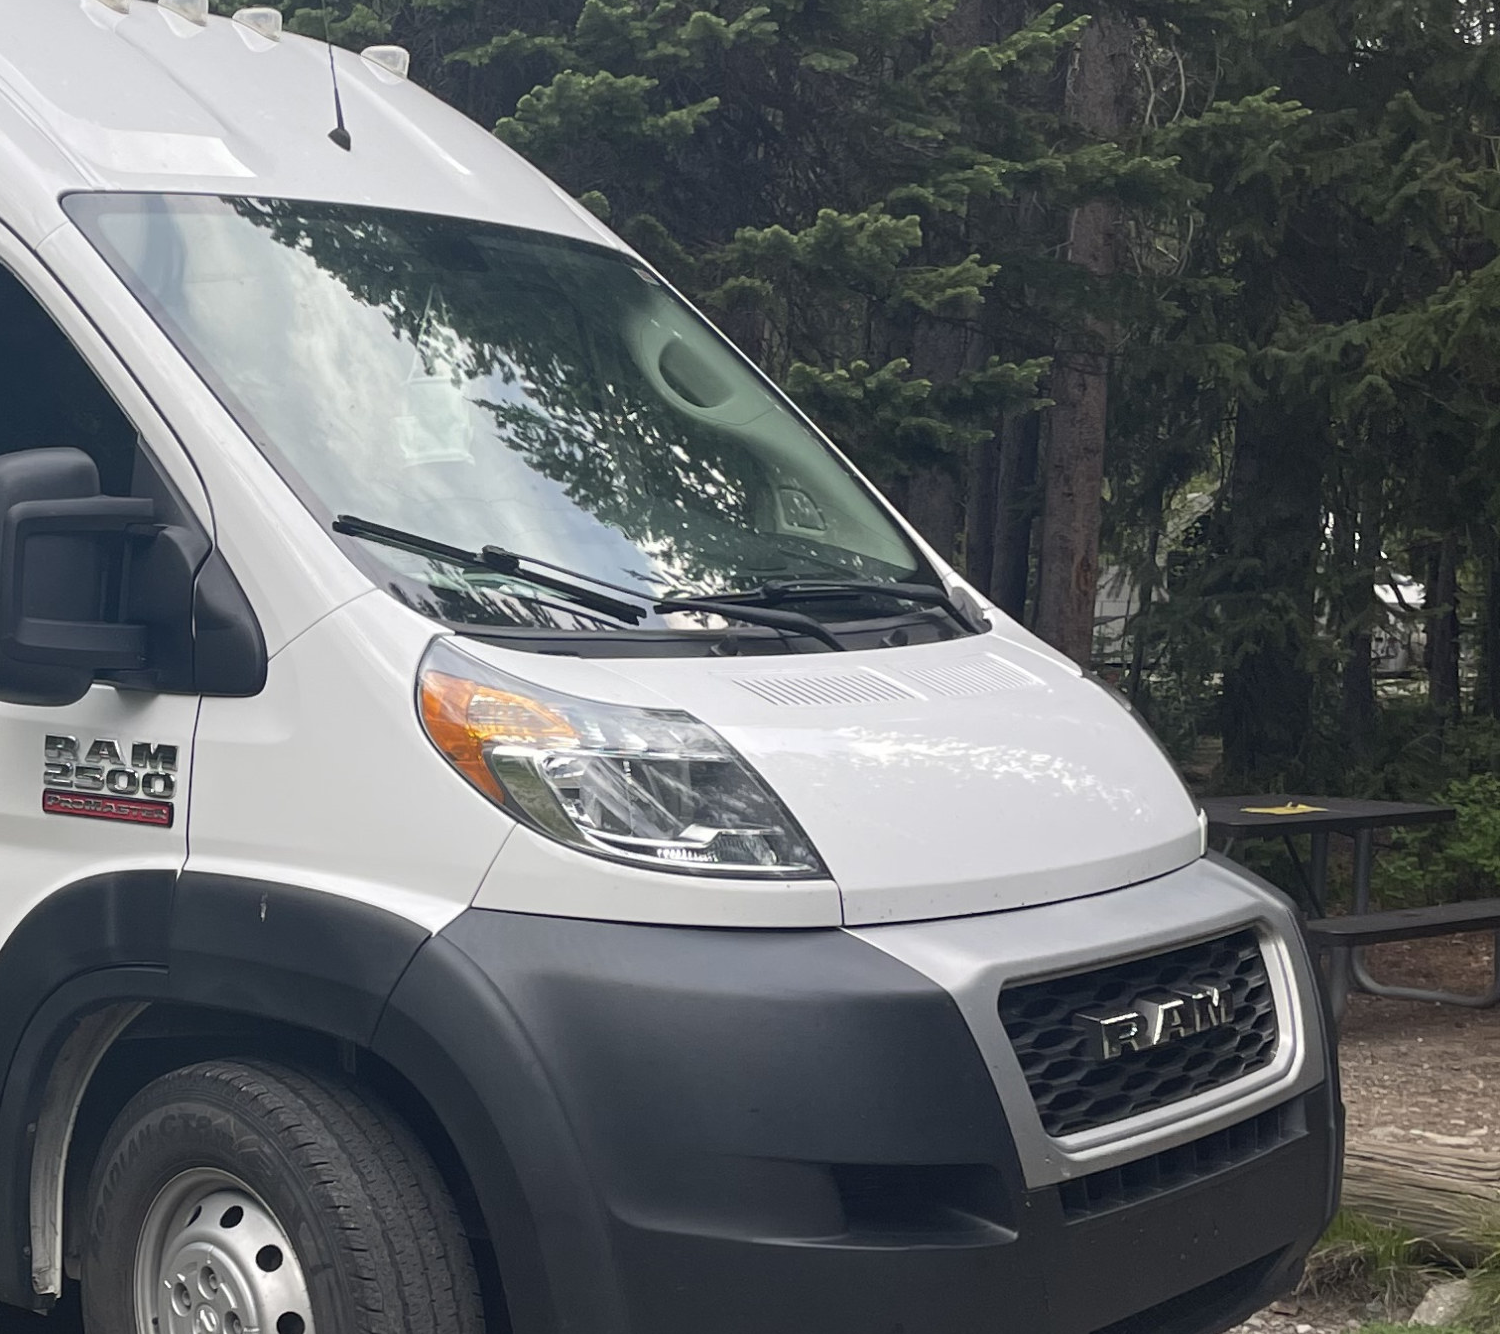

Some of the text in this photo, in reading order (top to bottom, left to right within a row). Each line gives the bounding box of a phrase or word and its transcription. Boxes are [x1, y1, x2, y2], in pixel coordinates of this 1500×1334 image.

[45, 734, 179, 772] RAM
[43, 762, 176, 799] 2500
[1099, 984, 1235, 1060] RAM
